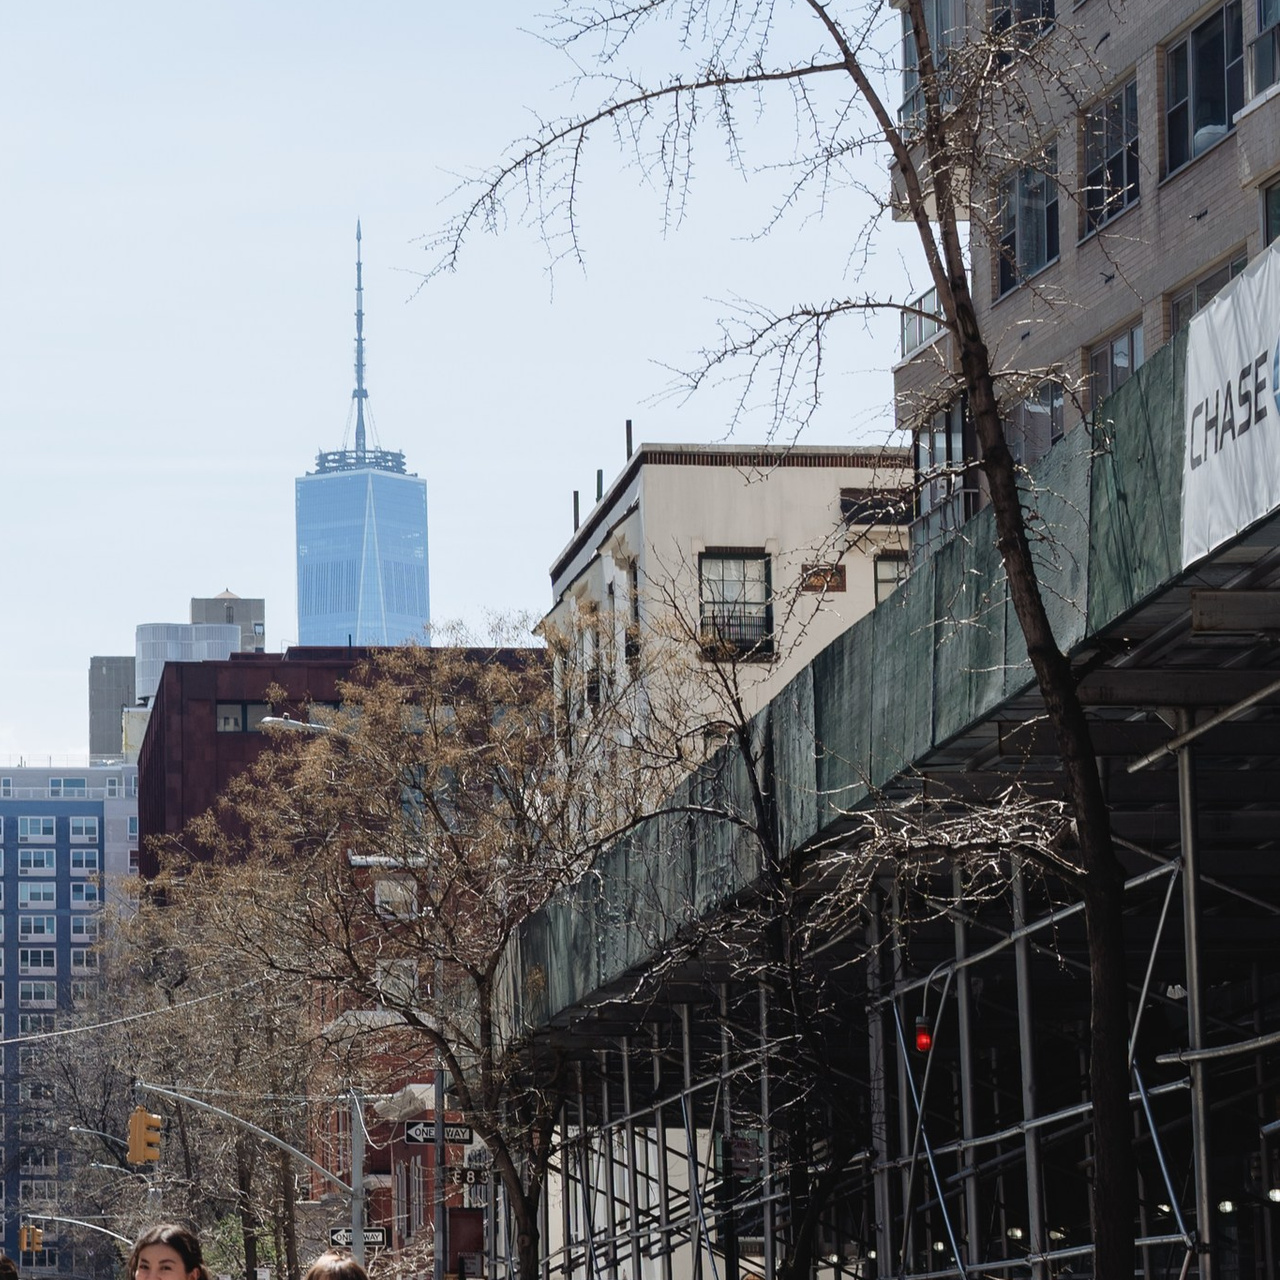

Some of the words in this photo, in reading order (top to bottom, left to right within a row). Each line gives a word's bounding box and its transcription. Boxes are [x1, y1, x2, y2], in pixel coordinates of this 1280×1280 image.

[1190, 350, 1268, 471] CHASE
[414, 1127, 434, 1137] ONE
[446, 1128, 467, 1138] WAY
[453, 1170, 461, 1183] E
[466, 1170, 475, 1183] 8
[336, 1233, 352, 1241] ONE
[363, 1233, 380, 1241] WAY
